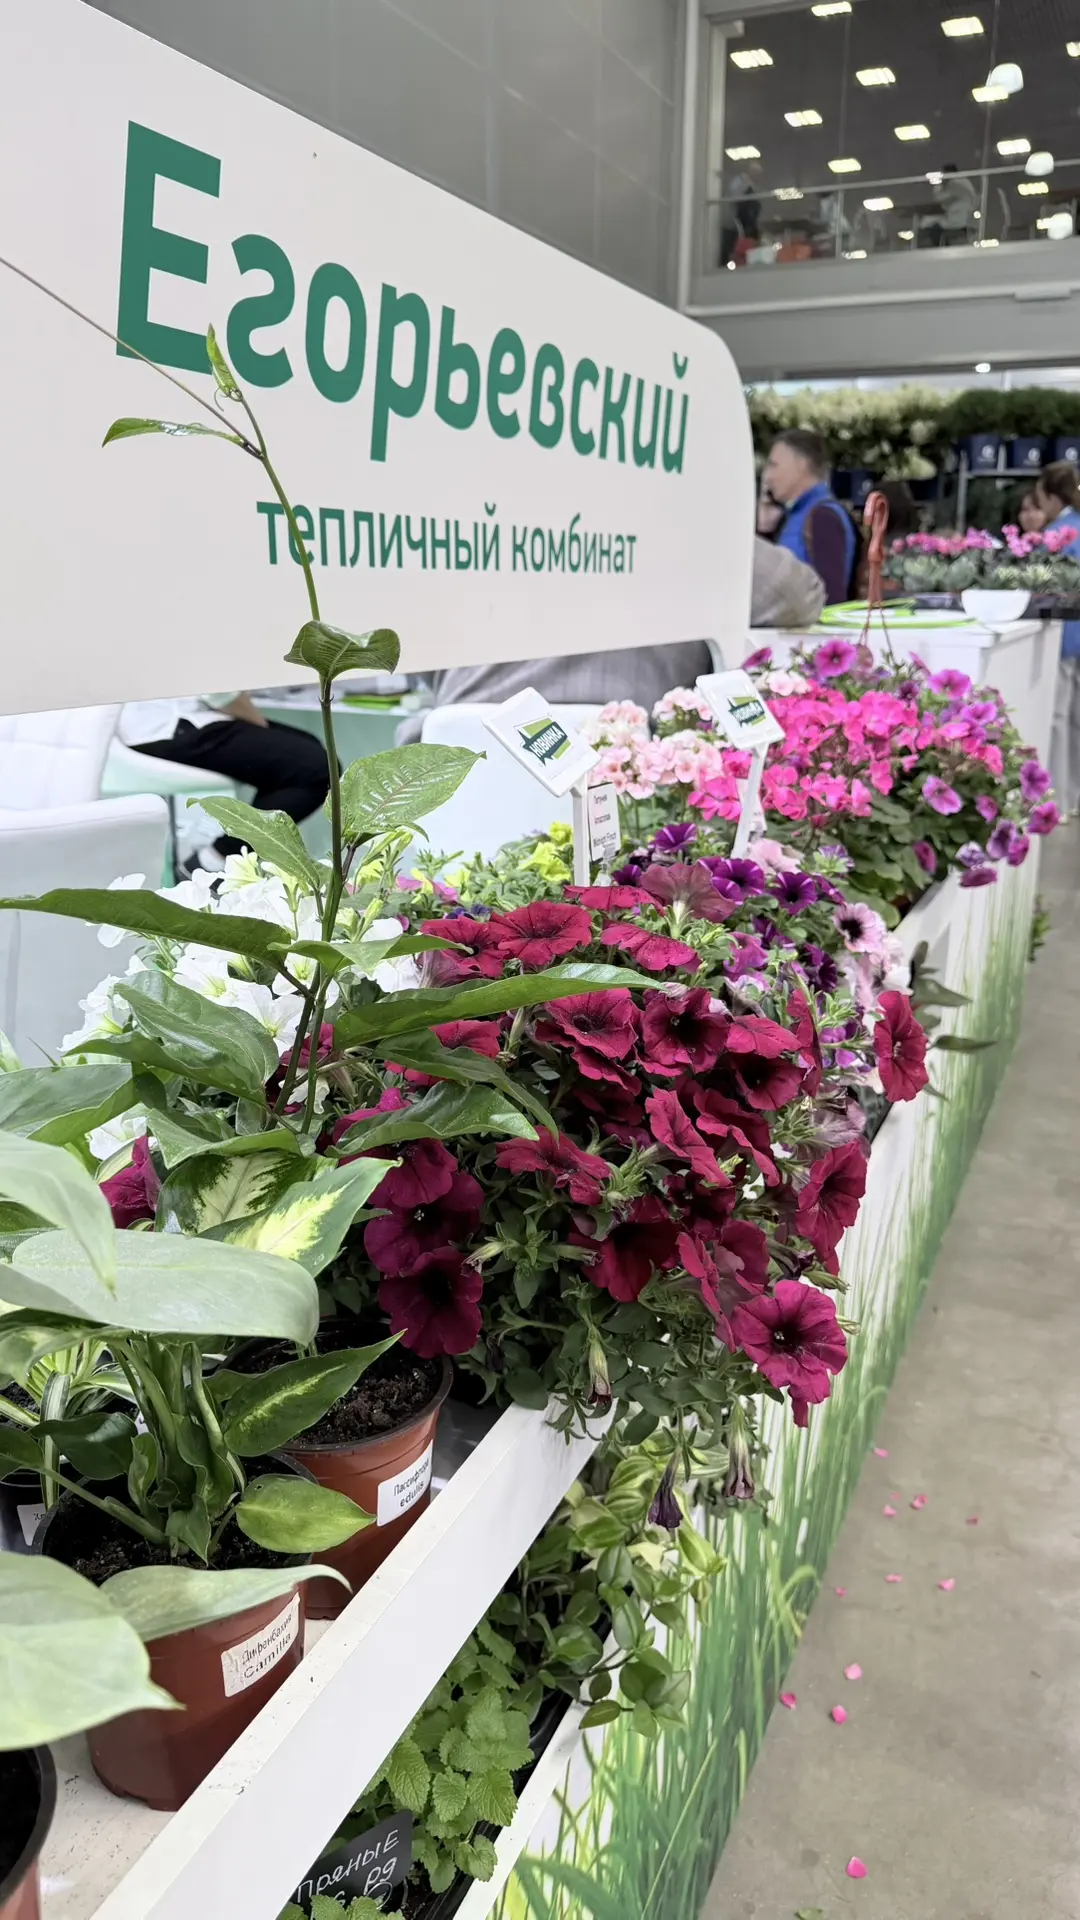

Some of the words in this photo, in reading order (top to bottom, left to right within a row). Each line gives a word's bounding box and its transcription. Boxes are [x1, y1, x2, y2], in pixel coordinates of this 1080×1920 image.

[116, 119, 689, 474] Егорьевский
[256, 501, 500, 571] тепличный
[512, 512, 637, 574] комбинат
[528, 725, 565, 758] НОВИНКА
[400, 1480, 424, 1507] edulis
[243, 1633, 291, 1679] Camilla
